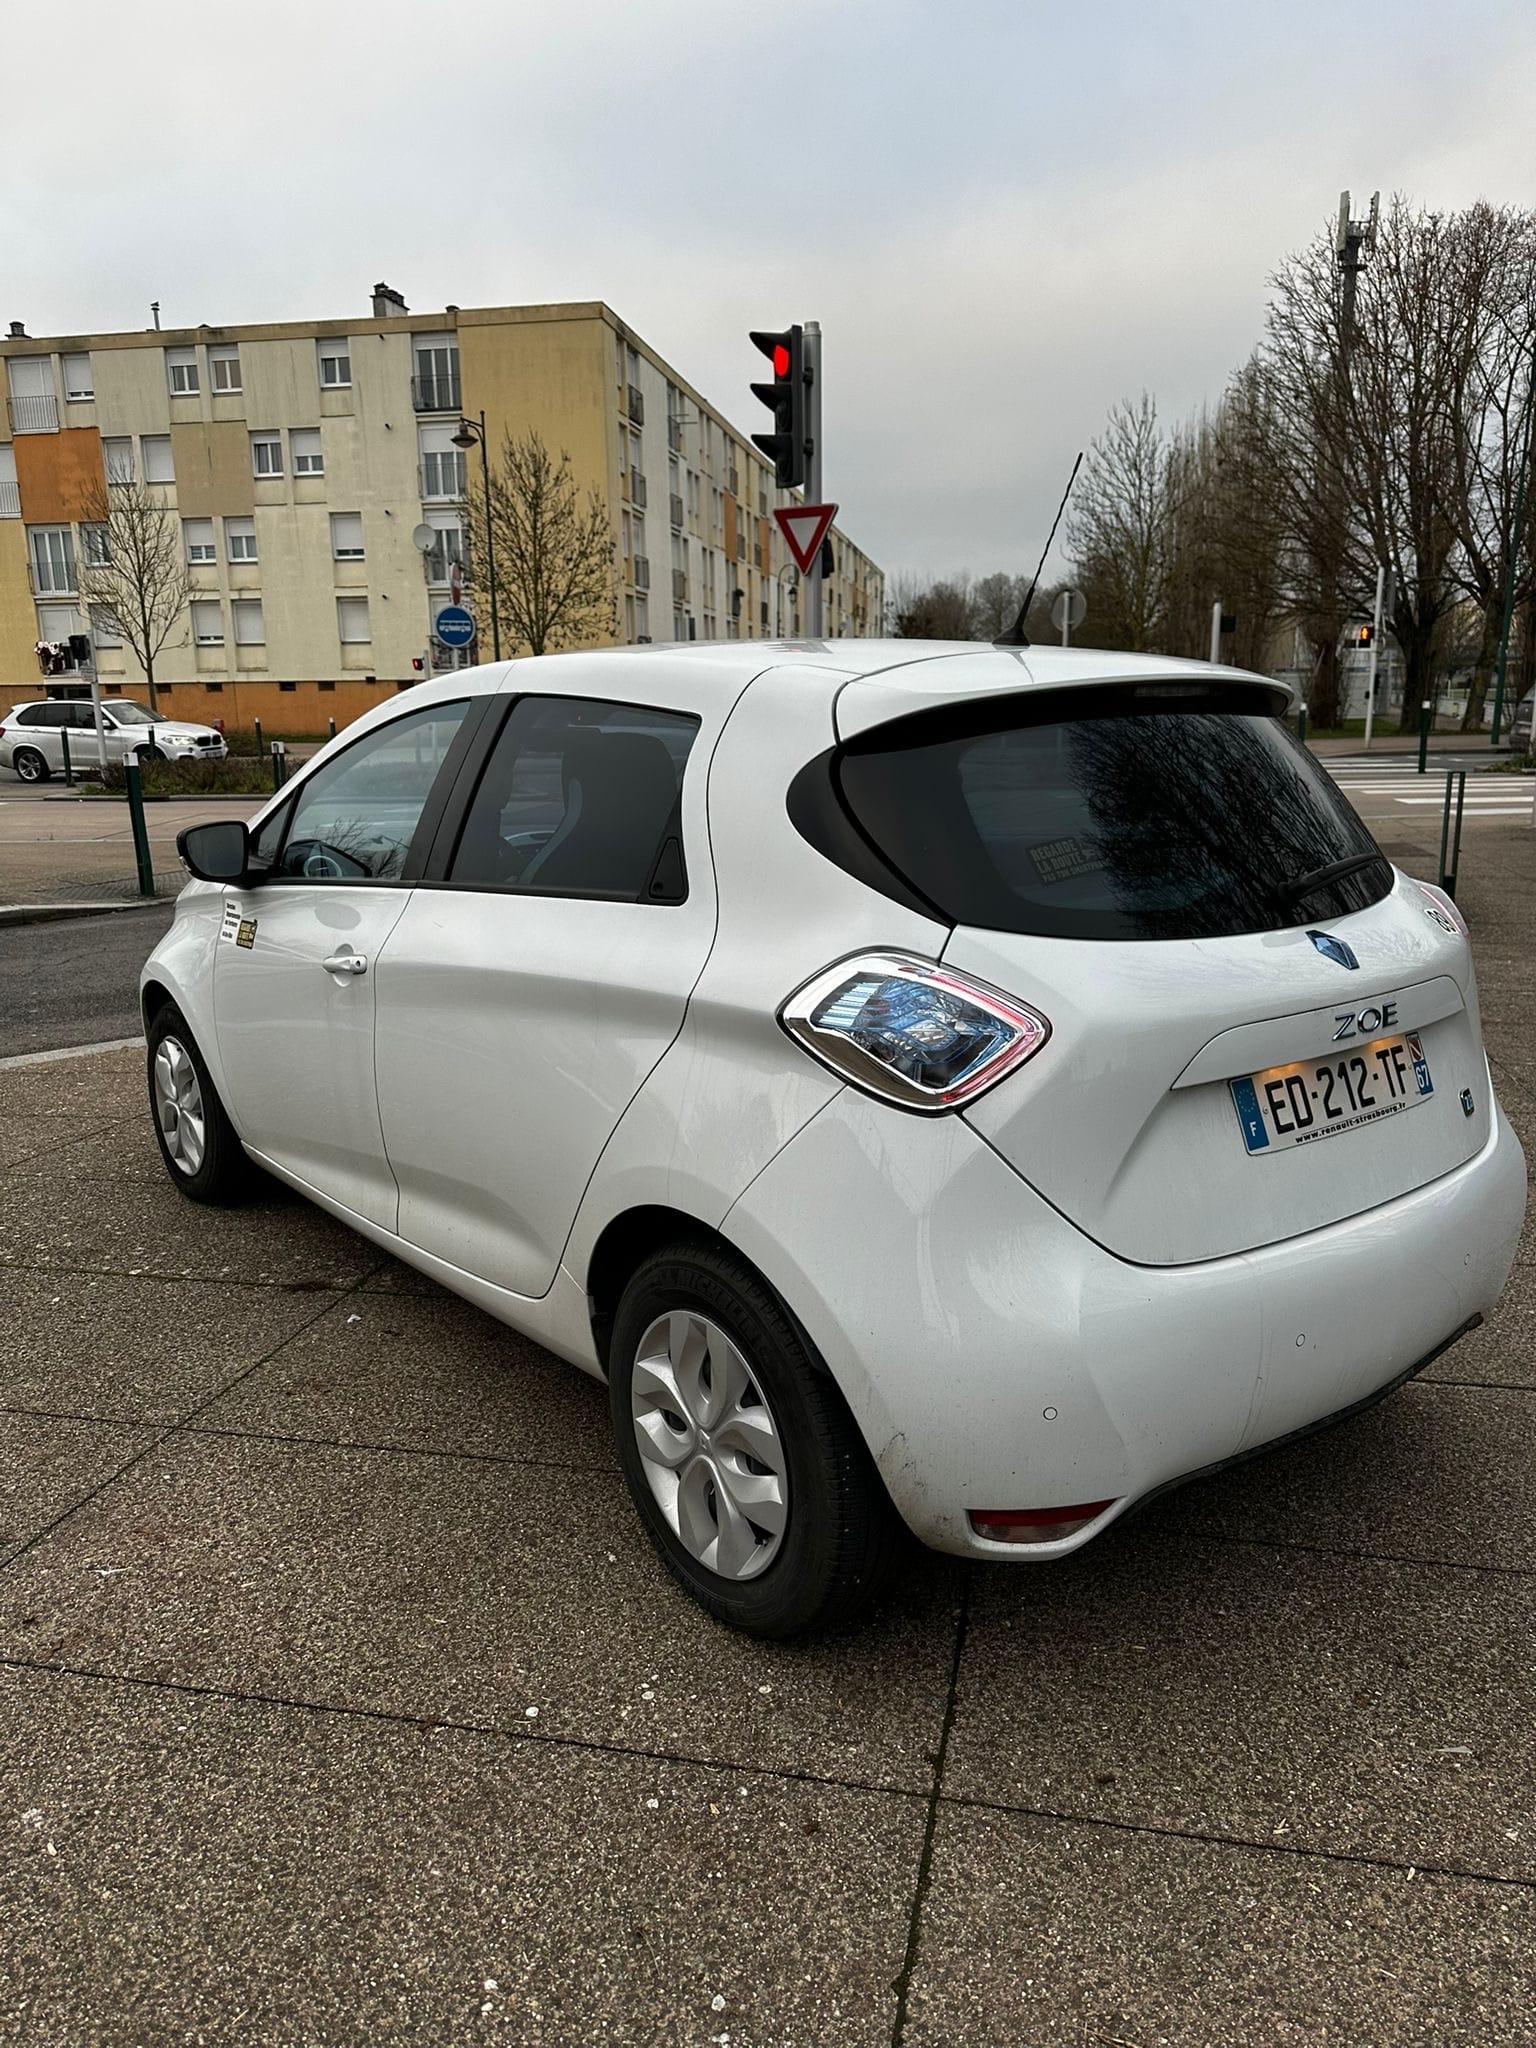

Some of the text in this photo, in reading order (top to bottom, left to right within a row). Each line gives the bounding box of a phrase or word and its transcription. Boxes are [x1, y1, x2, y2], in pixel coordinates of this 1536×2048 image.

[1029, 838, 1079, 862] REGARDE
[1050, 851, 1085, 870] ROUTE
[1331, 1001, 1400, 1042] ZOE
[1264, 1045, 1407, 1135] ED-212-TF
[1415, 1064, 1431, 1090] 67
[1249, 1121, 1257, 1137] F
[1295, 1102, 1407, 1143] www.renault-strasbourg.fr
